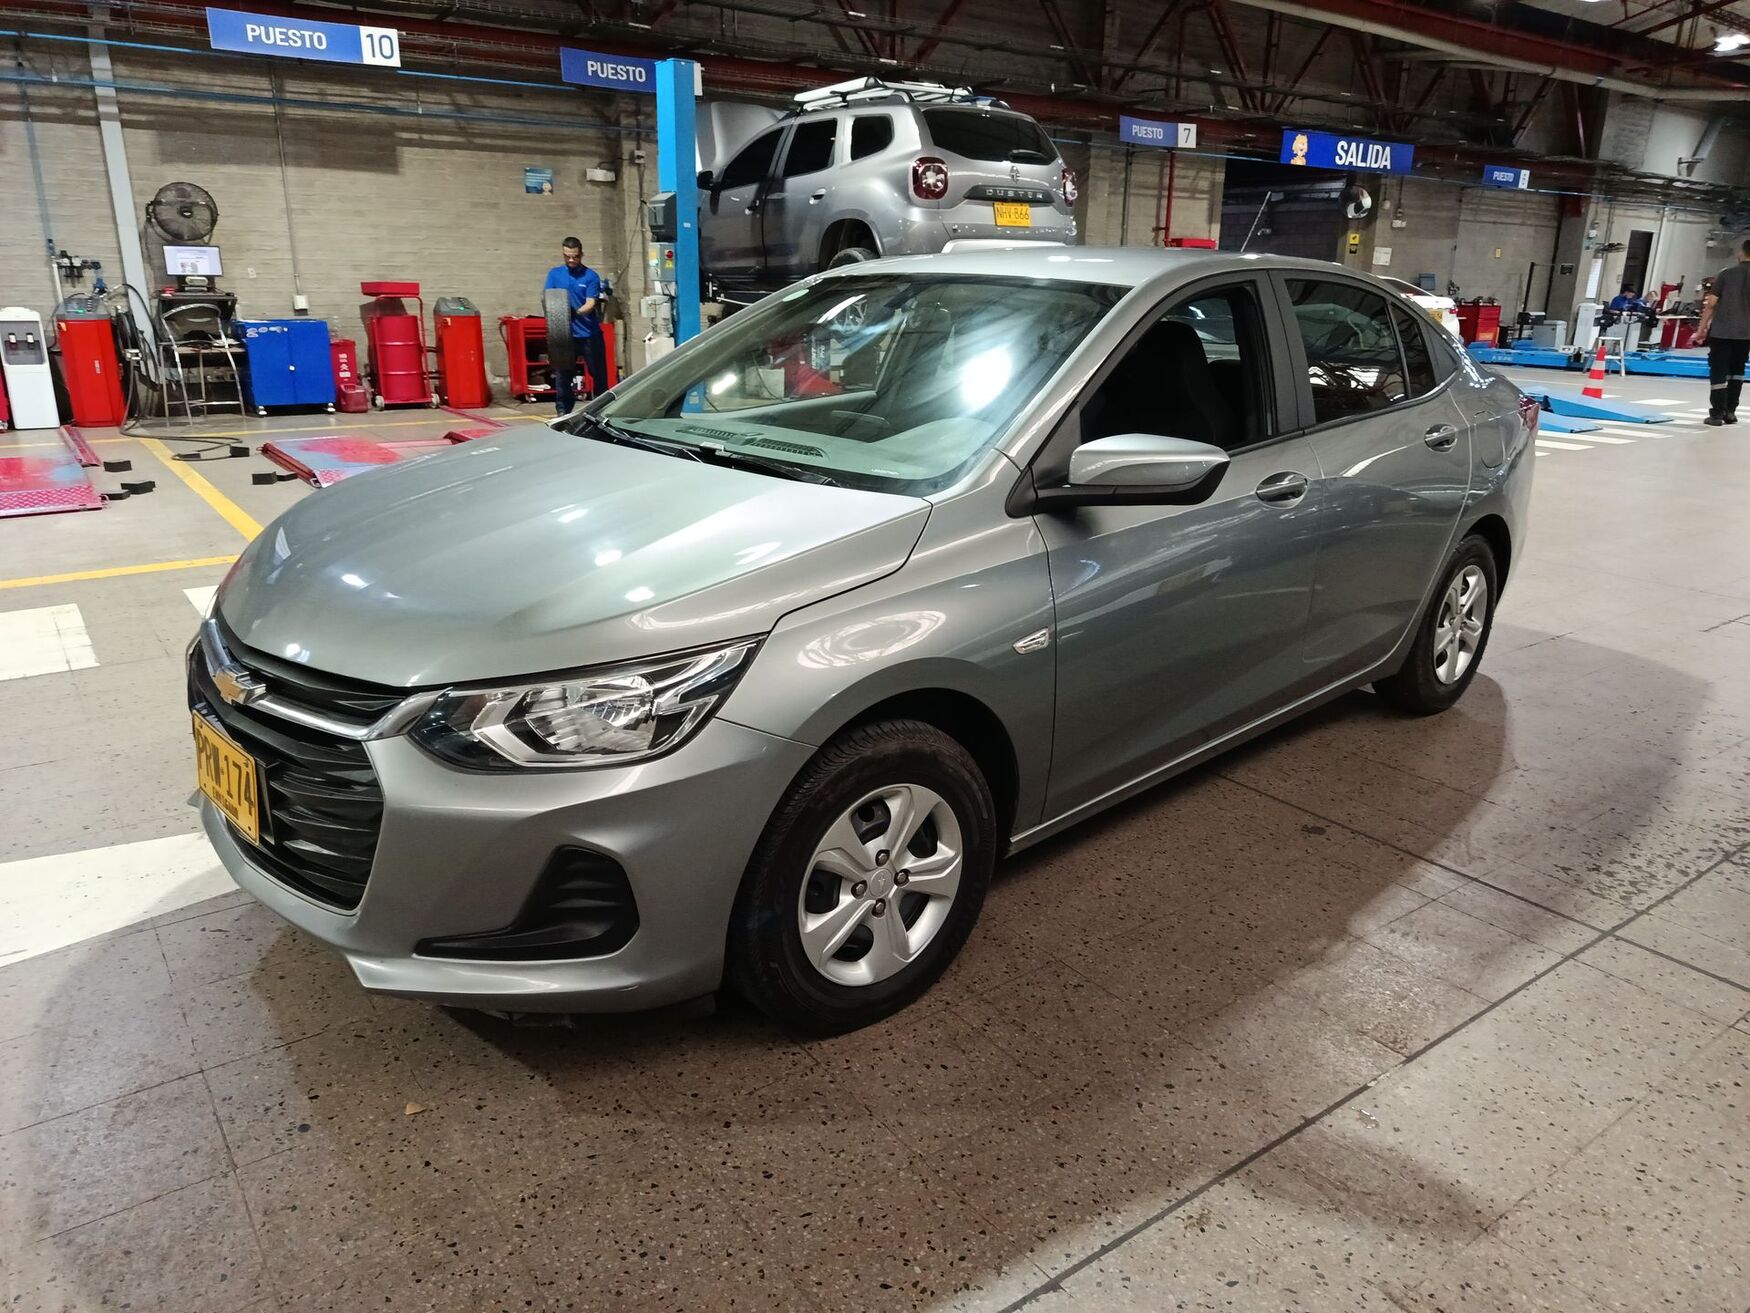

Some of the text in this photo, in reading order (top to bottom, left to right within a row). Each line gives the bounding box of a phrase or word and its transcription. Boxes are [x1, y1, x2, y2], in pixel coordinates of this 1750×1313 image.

[246, 24, 394, 59] PUESTO 10
[587, 60, 646, 82] PUESTO
[1132, 125, 1191, 143] PUESTO 7
[1335, 141, 1391, 169] SALIDA
[986, 189, 1042, 198] DUSTER
